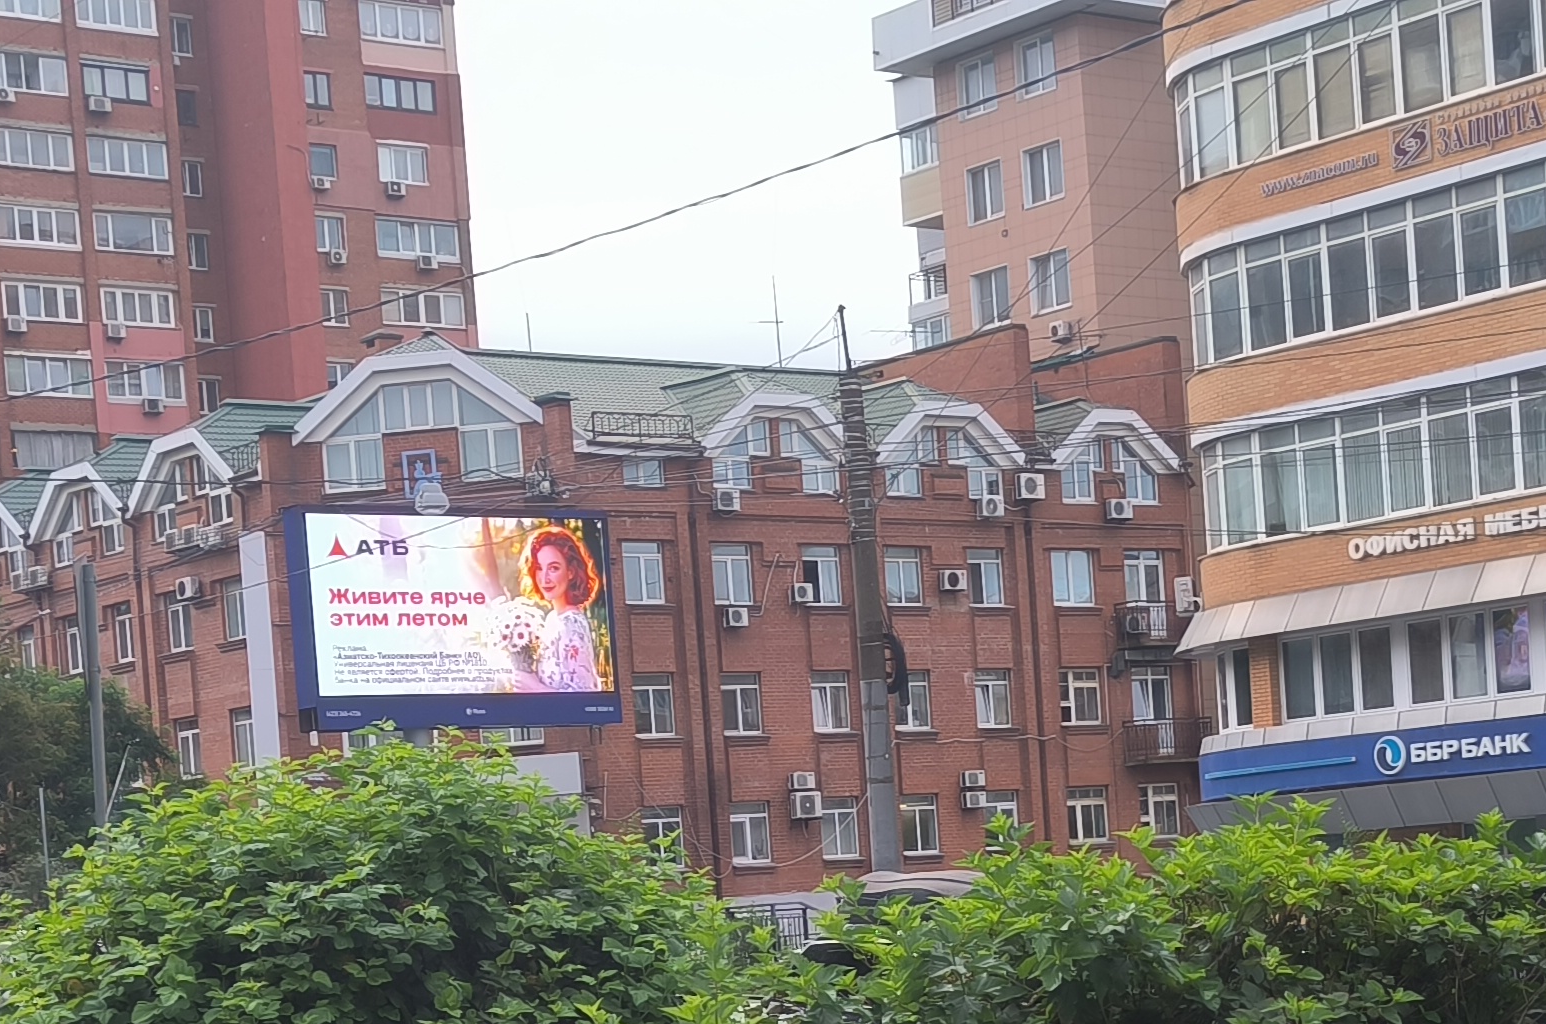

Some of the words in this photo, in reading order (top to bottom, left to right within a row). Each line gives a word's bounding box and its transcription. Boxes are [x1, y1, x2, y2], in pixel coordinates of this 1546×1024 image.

[355, 539, 409, 556] АТБ
[1347, 516, 1476, 561] ОФИСНАЯ
[328, 588, 423, 605] Живите
[430, 591, 486, 608] ярче
[330, 613, 389, 626] этим
[397, 613, 468, 626] летом
[1461, 732, 1532, 760] БАНК
